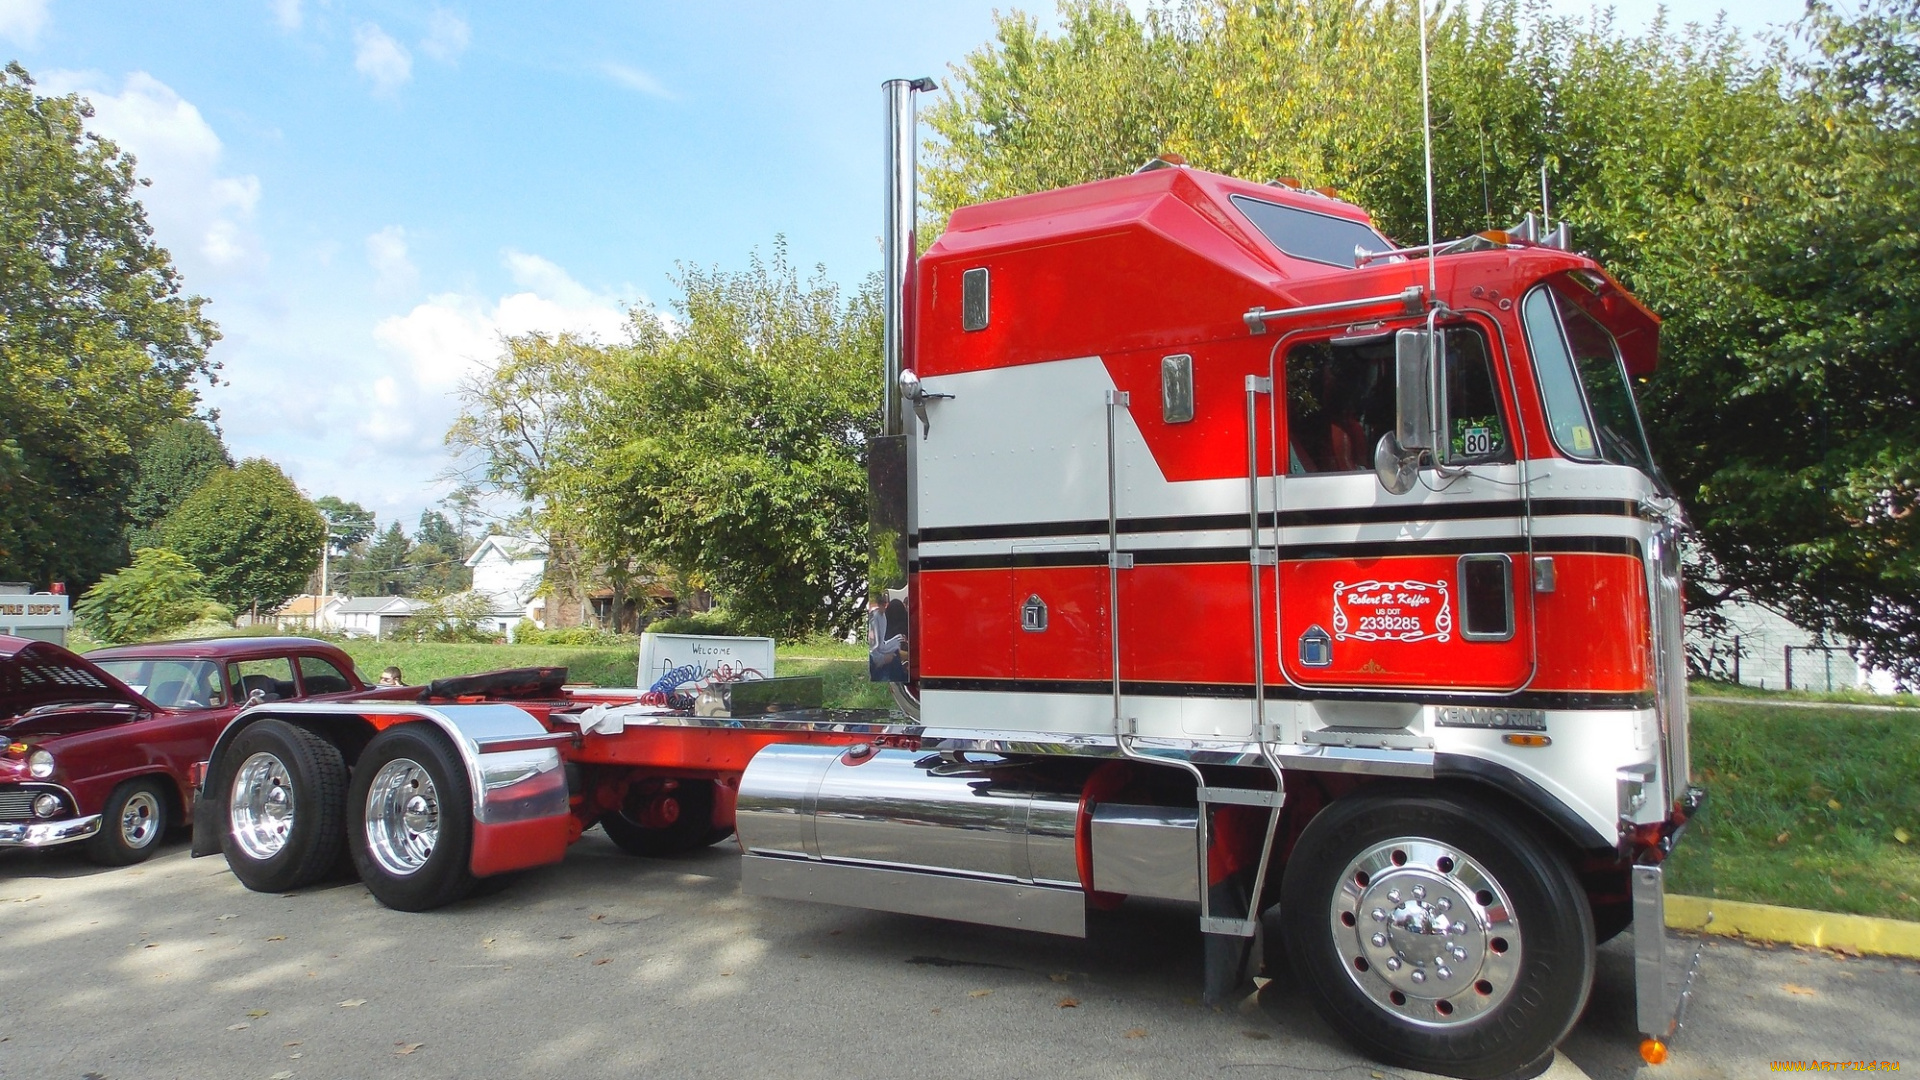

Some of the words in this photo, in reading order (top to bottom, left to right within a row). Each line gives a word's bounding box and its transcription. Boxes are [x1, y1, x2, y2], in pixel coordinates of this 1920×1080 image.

[1467, 434, 1487, 453] 80
[1347, 593, 1380, 605] Robert
[1381, 593, 1394, 605] R.
[1397, 593, 1430, 607] Keffer
[28, 604, 61, 615] DEPT.
[1360, 616, 1420, 630] 2338285
[1435, 707, 1546, 729] KENWORTH
